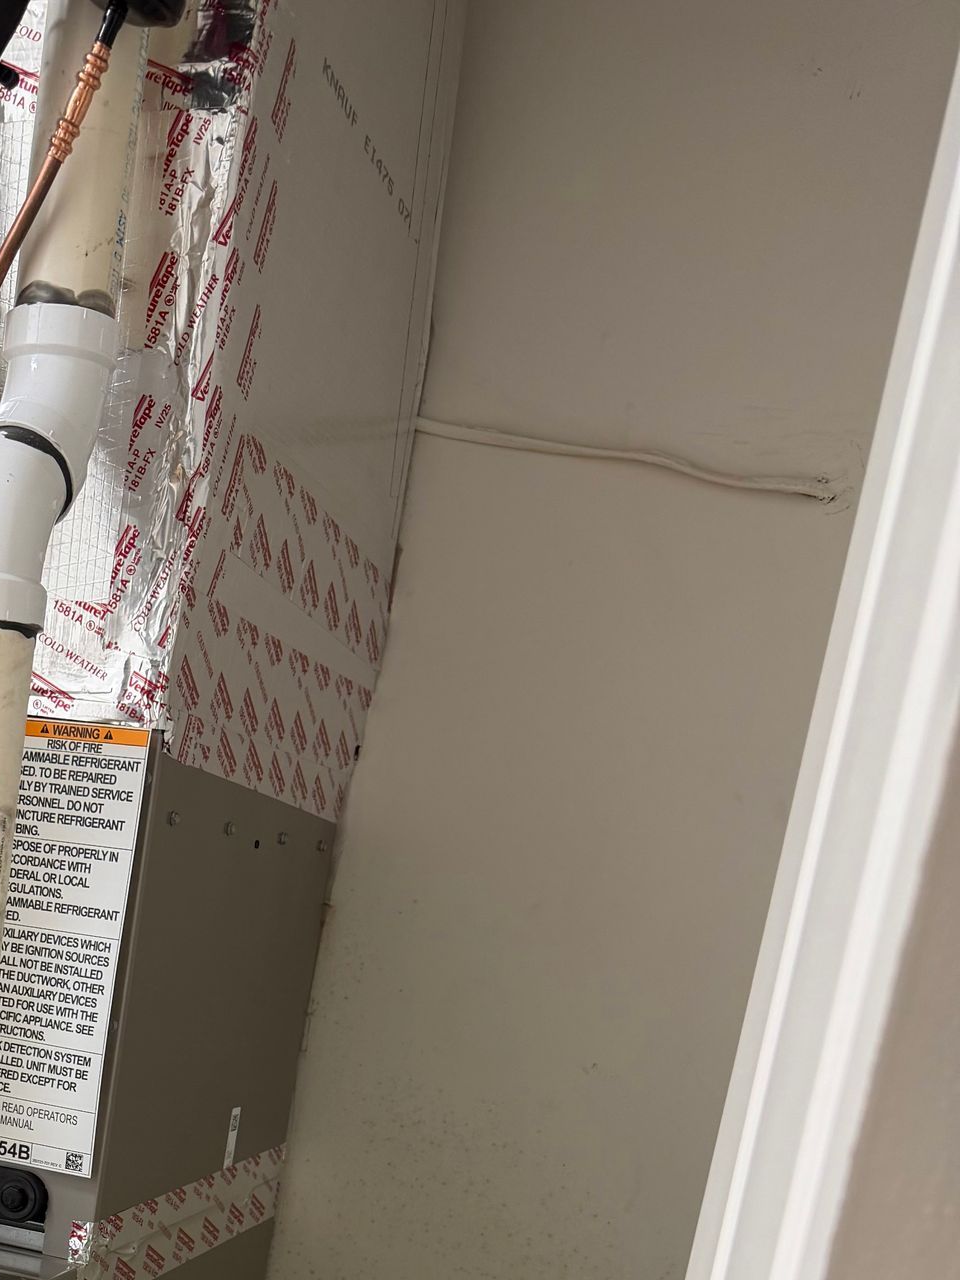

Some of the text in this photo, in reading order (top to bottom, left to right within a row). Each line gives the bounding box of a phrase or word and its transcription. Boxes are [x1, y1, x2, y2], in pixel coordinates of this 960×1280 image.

[322, 57, 358, 127] KNAUF
[193, 118, 211, 145] IV/25
[165, 168, 195, 216] 181B-FX
[188, 273, 219, 329] WEATHER
[144, 311, 169, 350] 1581A
[155, 403, 171, 428] IV/25
[128, 448, 156, 492] 181B-FX
[53, 600, 83, 625] 1581A
[38, 633, 107, 681] COLD WEATHER
[53, 725, 100, 740] WARNING
[47, 739, 102, 754] RISK OF FIRE
[72, 756, 141, 773] REFRIGERANT
[39, 767, 116, 785] TO BE REPAIRED
[34, 783, 133, 802] BY TRAINED SERVICE
[67, 800, 104, 814] DO NOT
[16, 824, 39, 836] BING.
[57, 812, 125, 831] REFRIGERANT
[44, 843, 118, 862] OF PROPERLY IN
[67, 860, 91, 873] WITH
[43, 873, 89, 887] OR LOCAL
[54, 903, 119, 921] REFRIGERANT
[41, 933, 111, 953] DEVICES WHICH
[11, 944, 109, 967] BE IGNITION SOURCES
[20, 959, 103, 980] NOT BE INSTALLED
[0, 970, 105, 995] THE DUCTWORK, OTHER
[12, 985, 97, 1008] AUXILIARY DEVICES
[16, 999, 98, 1022] FOR USE WITH THE
[23, 1014, 94, 1036] APPLIANCE. SEE
[4, 1041, 91, 1067] DETECTION SYSTEM
[26, 1060, 88, 1080] UNIT MUST BE
[20, 1072, 77, 1092] EXCEPT FOR
[0, 1117, 34, 1131] MANUAL
[2, 1102, 78, 1125] READ OPERATORS
